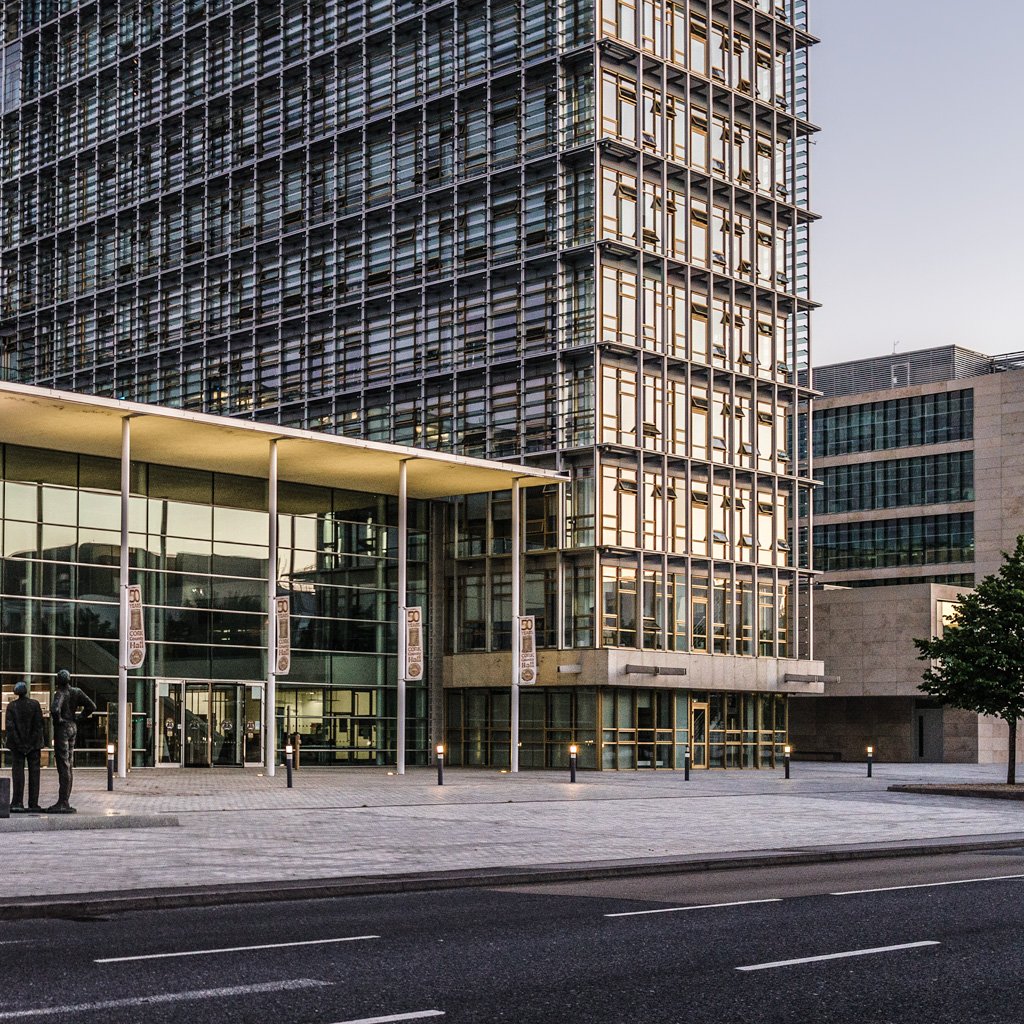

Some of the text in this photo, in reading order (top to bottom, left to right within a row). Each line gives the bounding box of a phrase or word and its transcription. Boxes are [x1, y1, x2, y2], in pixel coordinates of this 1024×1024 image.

[129, 588, 140, 602] 50
[278, 600, 288, 613] 50
[408, 611, 420, 622] 50
[521, 619, 533, 630] 50
